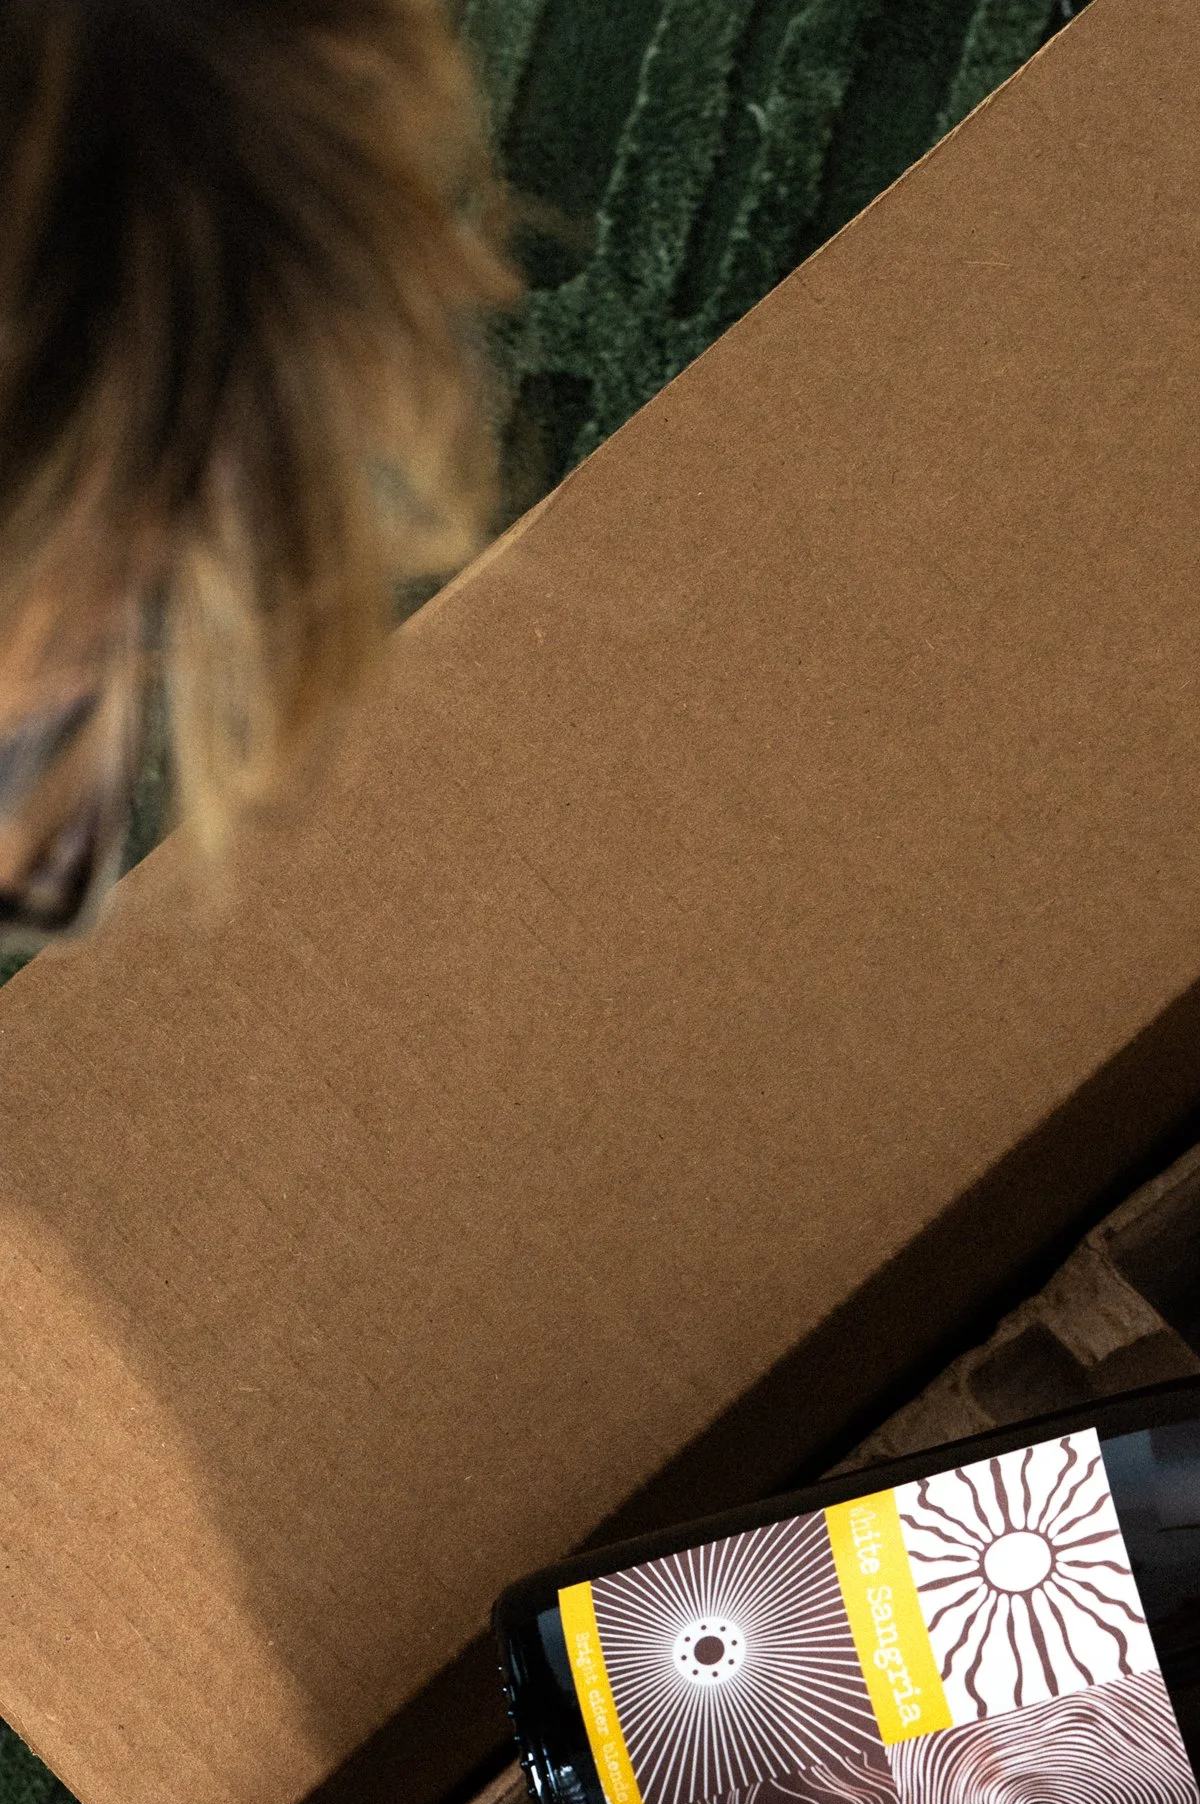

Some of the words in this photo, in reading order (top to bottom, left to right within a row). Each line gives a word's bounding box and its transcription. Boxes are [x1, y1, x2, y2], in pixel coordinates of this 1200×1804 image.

[850, 1501, 883, 1576] White
[867, 1585, 922, 1728] Sangria
[576, 1632, 599, 1684] Bright
[589, 1690, 610, 1735] cider
[604, 1742, 629, 1802] blends
